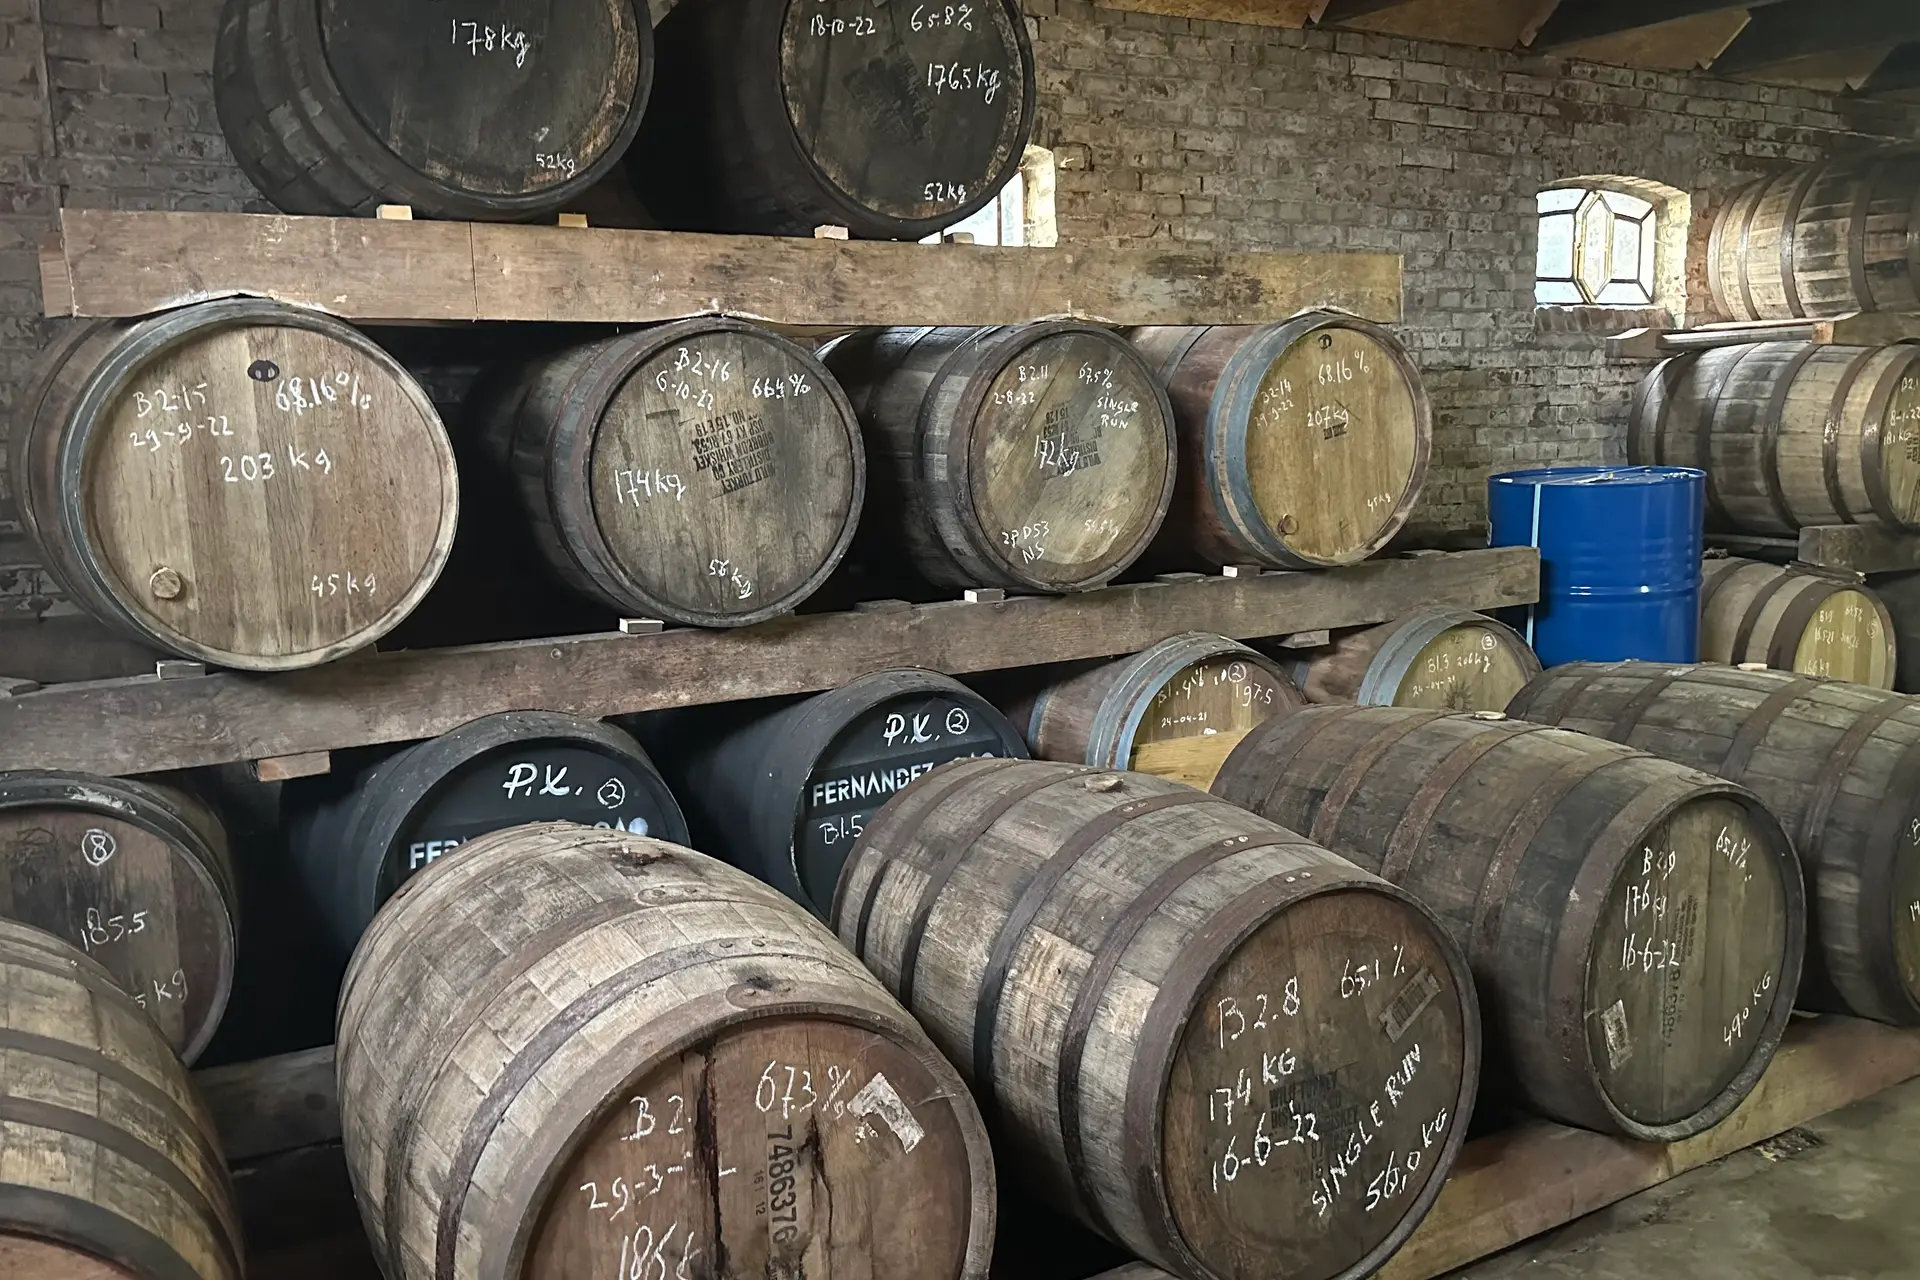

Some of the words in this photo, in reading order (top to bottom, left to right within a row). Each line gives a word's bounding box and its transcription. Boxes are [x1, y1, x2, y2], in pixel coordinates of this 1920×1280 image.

[810, 14, 876, 37] 18-10-22
[129, 415, 234, 452] 29-9-22
[1100, 413, 1129, 430] RUN
[220, 453, 276, 483] 203
[288, 443, 332, 475] kg
[80, 907, 149, 952] 185.5
[1209, 1068, 1252, 1126] 174
[1384, 1043, 1422, 1109] RUN
[766, 1123, 799, 1246] 7486376
